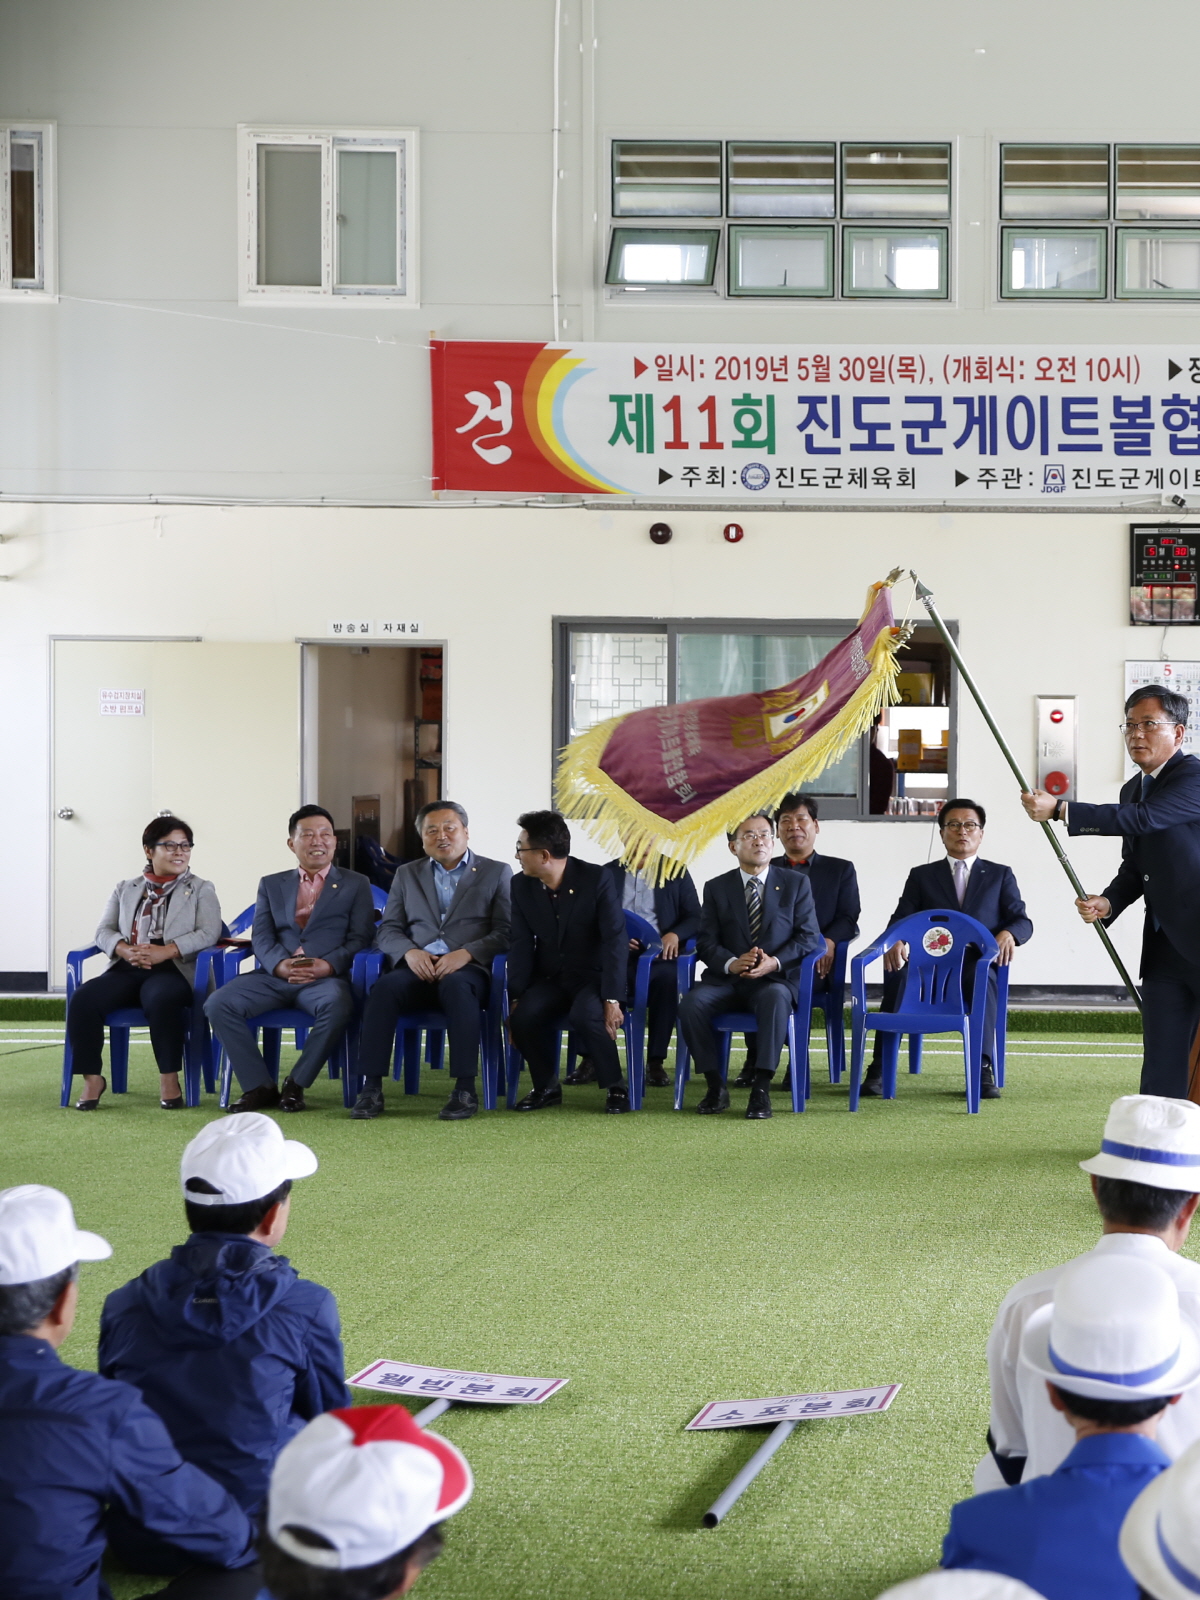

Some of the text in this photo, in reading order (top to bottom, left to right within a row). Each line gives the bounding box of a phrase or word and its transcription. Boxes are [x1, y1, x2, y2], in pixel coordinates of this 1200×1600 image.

[654, 354, 1141, 385] 일시: 2019년 5월 30일(목), (개회식: 오전 10시)
[455, 380, 513, 465] 건
[607, 393, 776, 455] 제11회
[775, 466, 916, 489] 진도군체육회
[1040, 485, 1067, 494] JDGF
[1174, 547, 1187, 556] 30
[333, 623, 369, 633] 방송실
[383, 623, 419, 633] 자재실
[1163, 664, 1172, 677] 5
[710, 1395, 877, 1421] 소포분회
